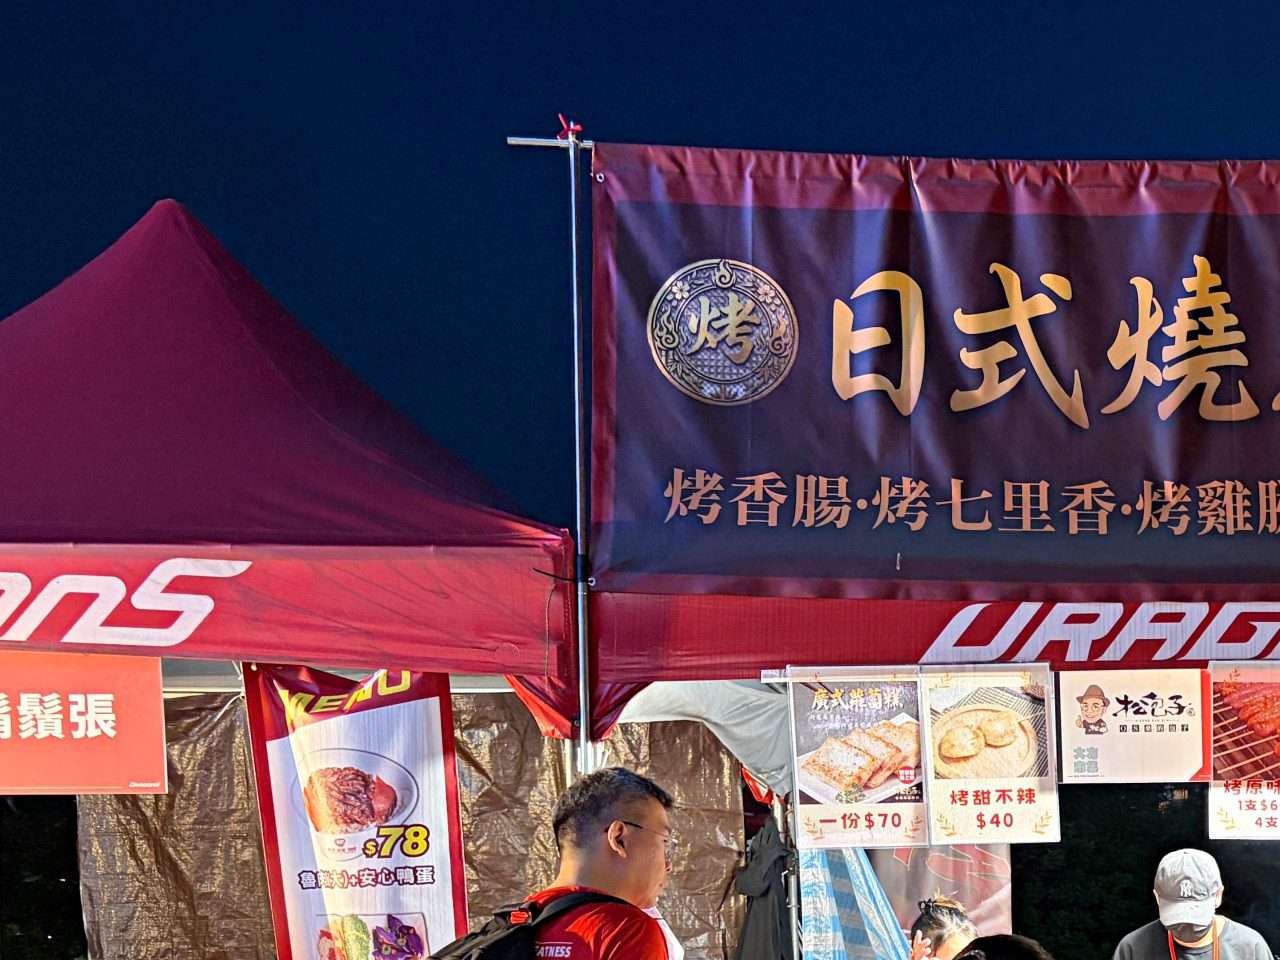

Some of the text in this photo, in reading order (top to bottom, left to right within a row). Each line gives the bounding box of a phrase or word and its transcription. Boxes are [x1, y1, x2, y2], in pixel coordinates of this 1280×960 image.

[685, 296, 762, 366] 烤
[0, 692, 117, 740] 鬚張
[949, 787, 1036, 806] 烤甜不辣
[976, 812, 1014, 830] $40
[362, 824, 430, 859] $78
